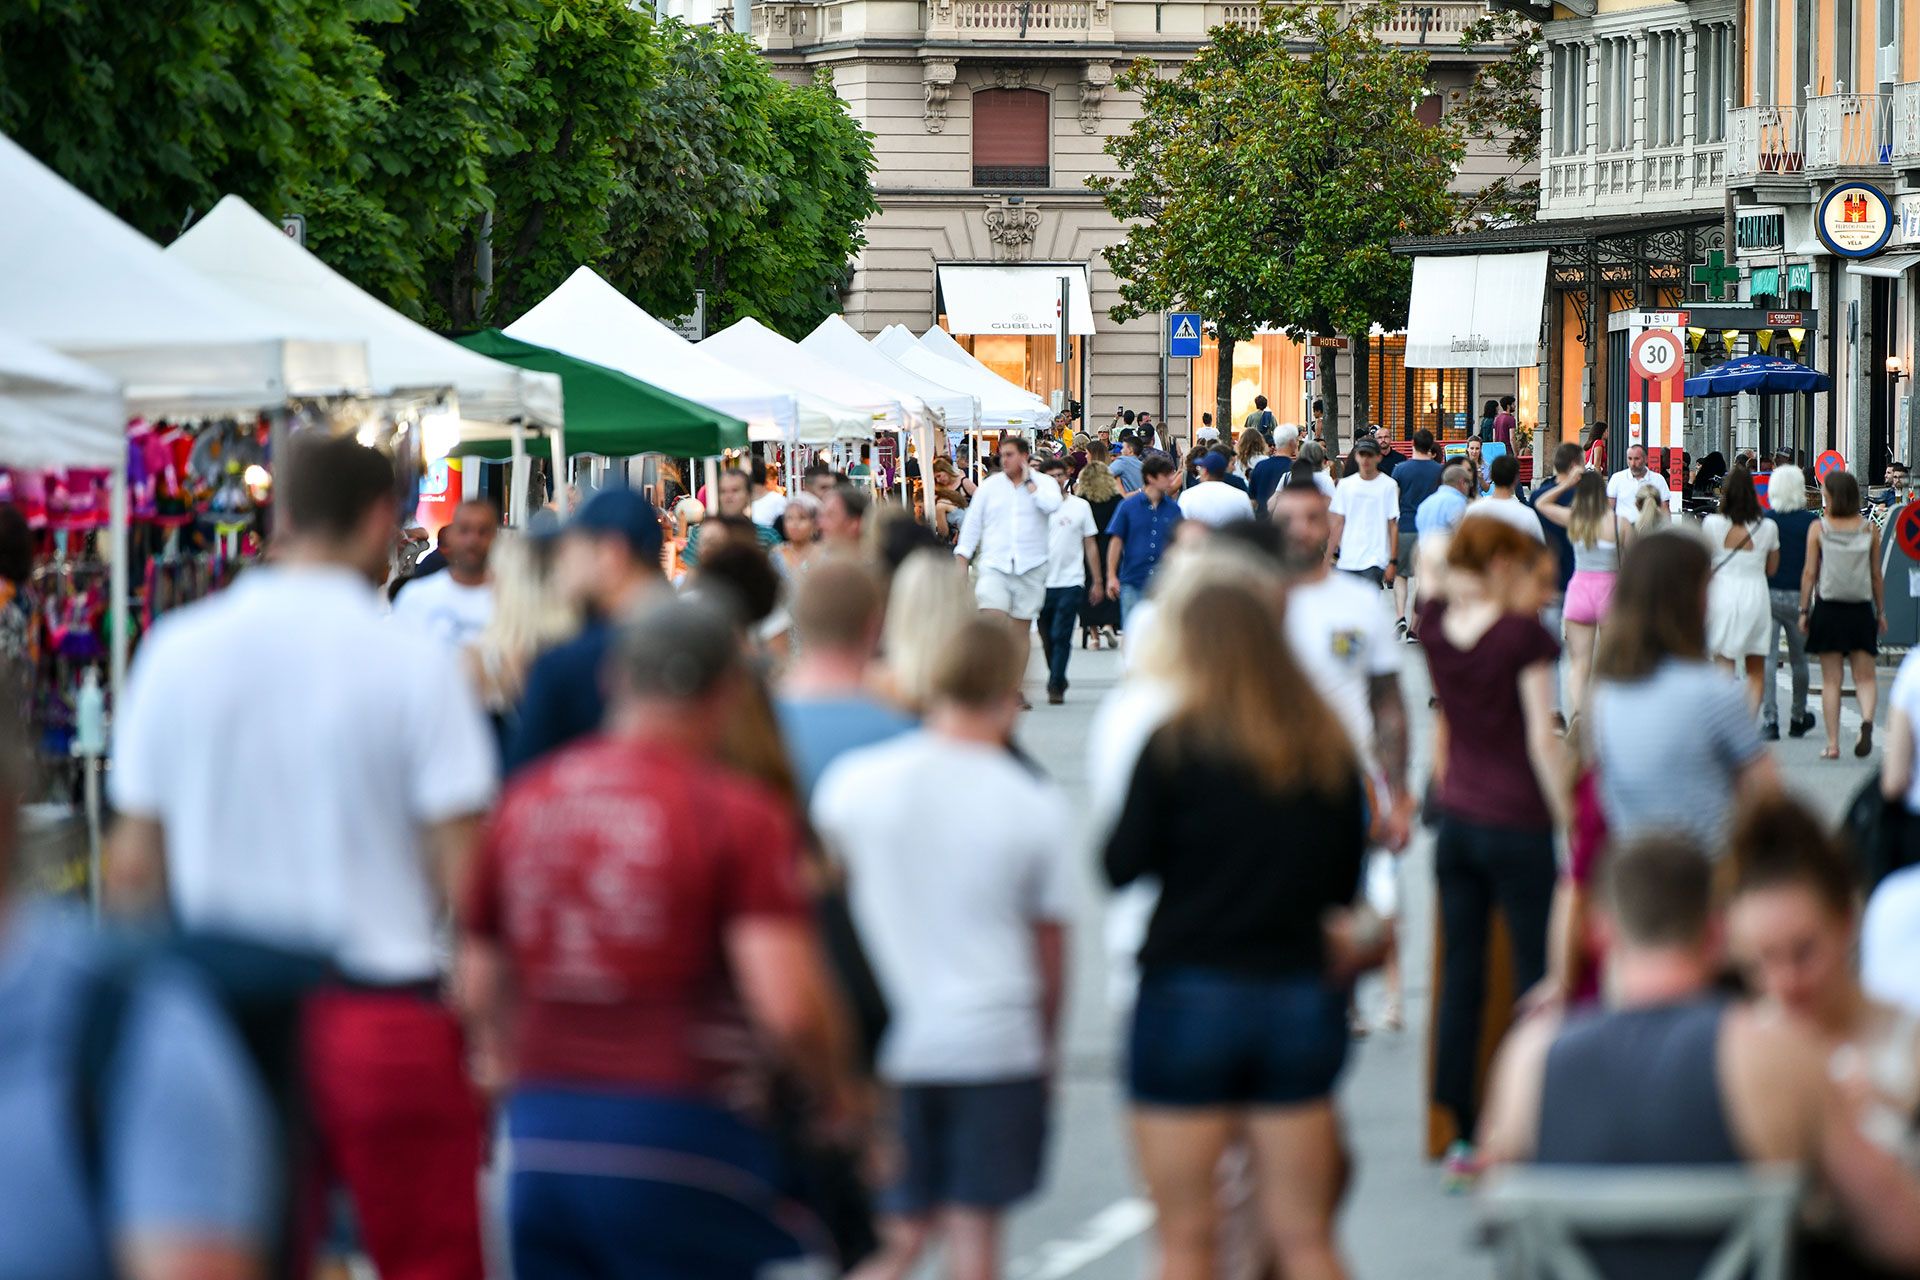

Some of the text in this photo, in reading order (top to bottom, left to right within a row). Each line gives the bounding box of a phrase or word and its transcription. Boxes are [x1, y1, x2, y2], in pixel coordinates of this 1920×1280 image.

[1737, 214, 1779, 248] FARMACIA
[1320, 338, 1340, 347] HOTEL
[1647, 345, 1667, 364] 30
[1672, 458, 1682, 485] DSU
